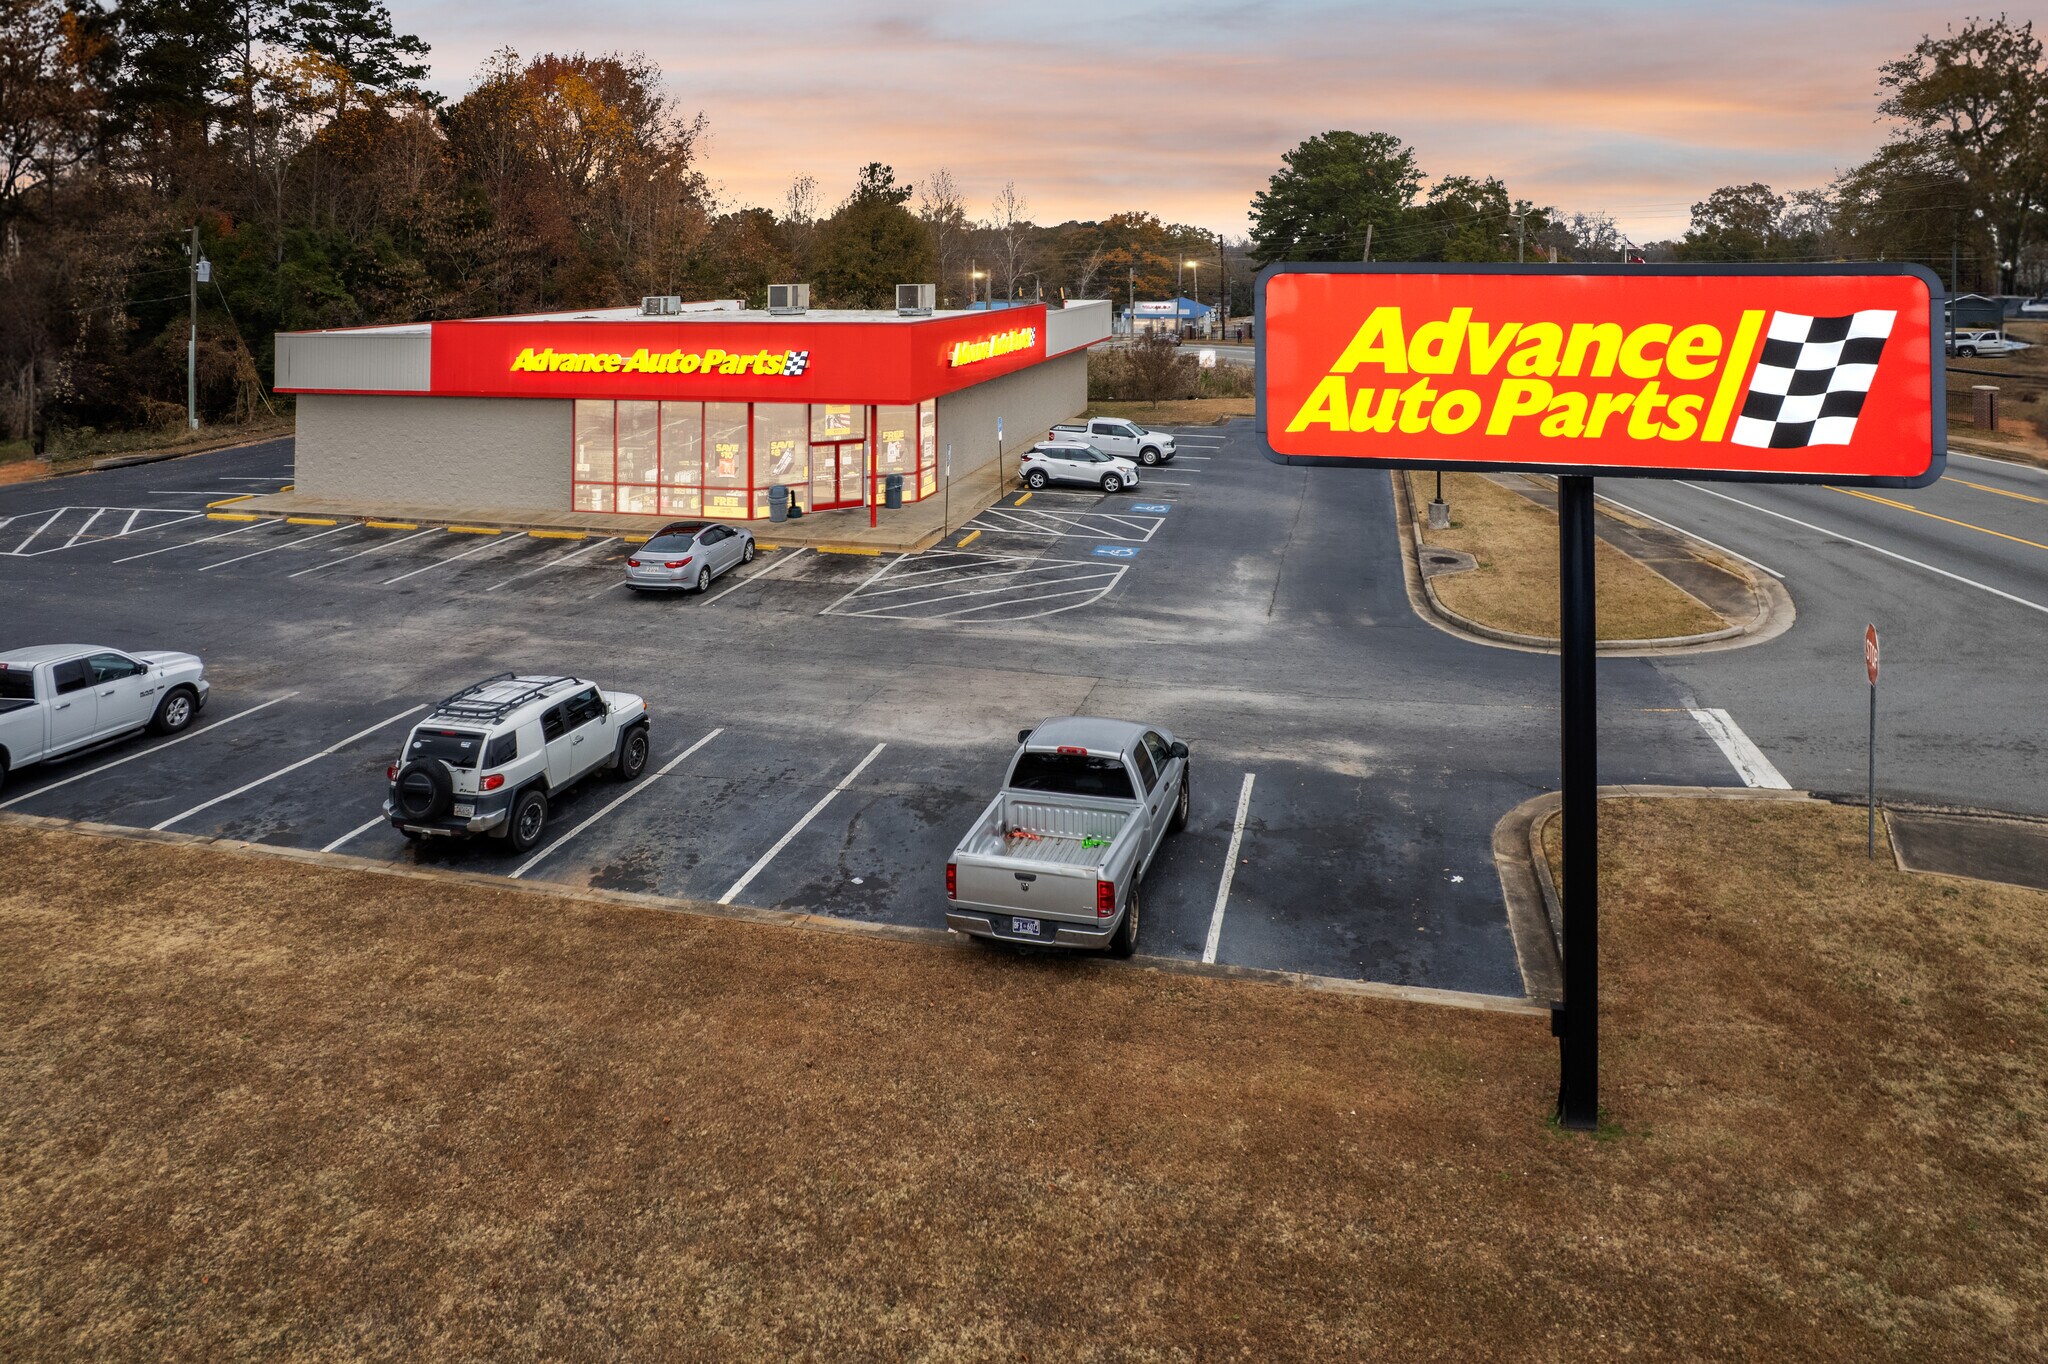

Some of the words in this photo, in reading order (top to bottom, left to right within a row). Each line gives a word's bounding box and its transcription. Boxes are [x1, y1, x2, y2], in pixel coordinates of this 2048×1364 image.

[1329, 306, 1723, 379] Advance
[510, 348, 622, 372] Advance
[622, 348, 701, 374] Auto
[700, 349, 783, 375] Parts
[1285, 375, 1482, 435] Auto
[1485, 378, 1705, 442] Parts
[882, 430, 905, 440] FREE
[715, 443, 740, 452] SAVE
[770, 440, 795, 450] SAVE
[713, 496, 739, 506] FREE
